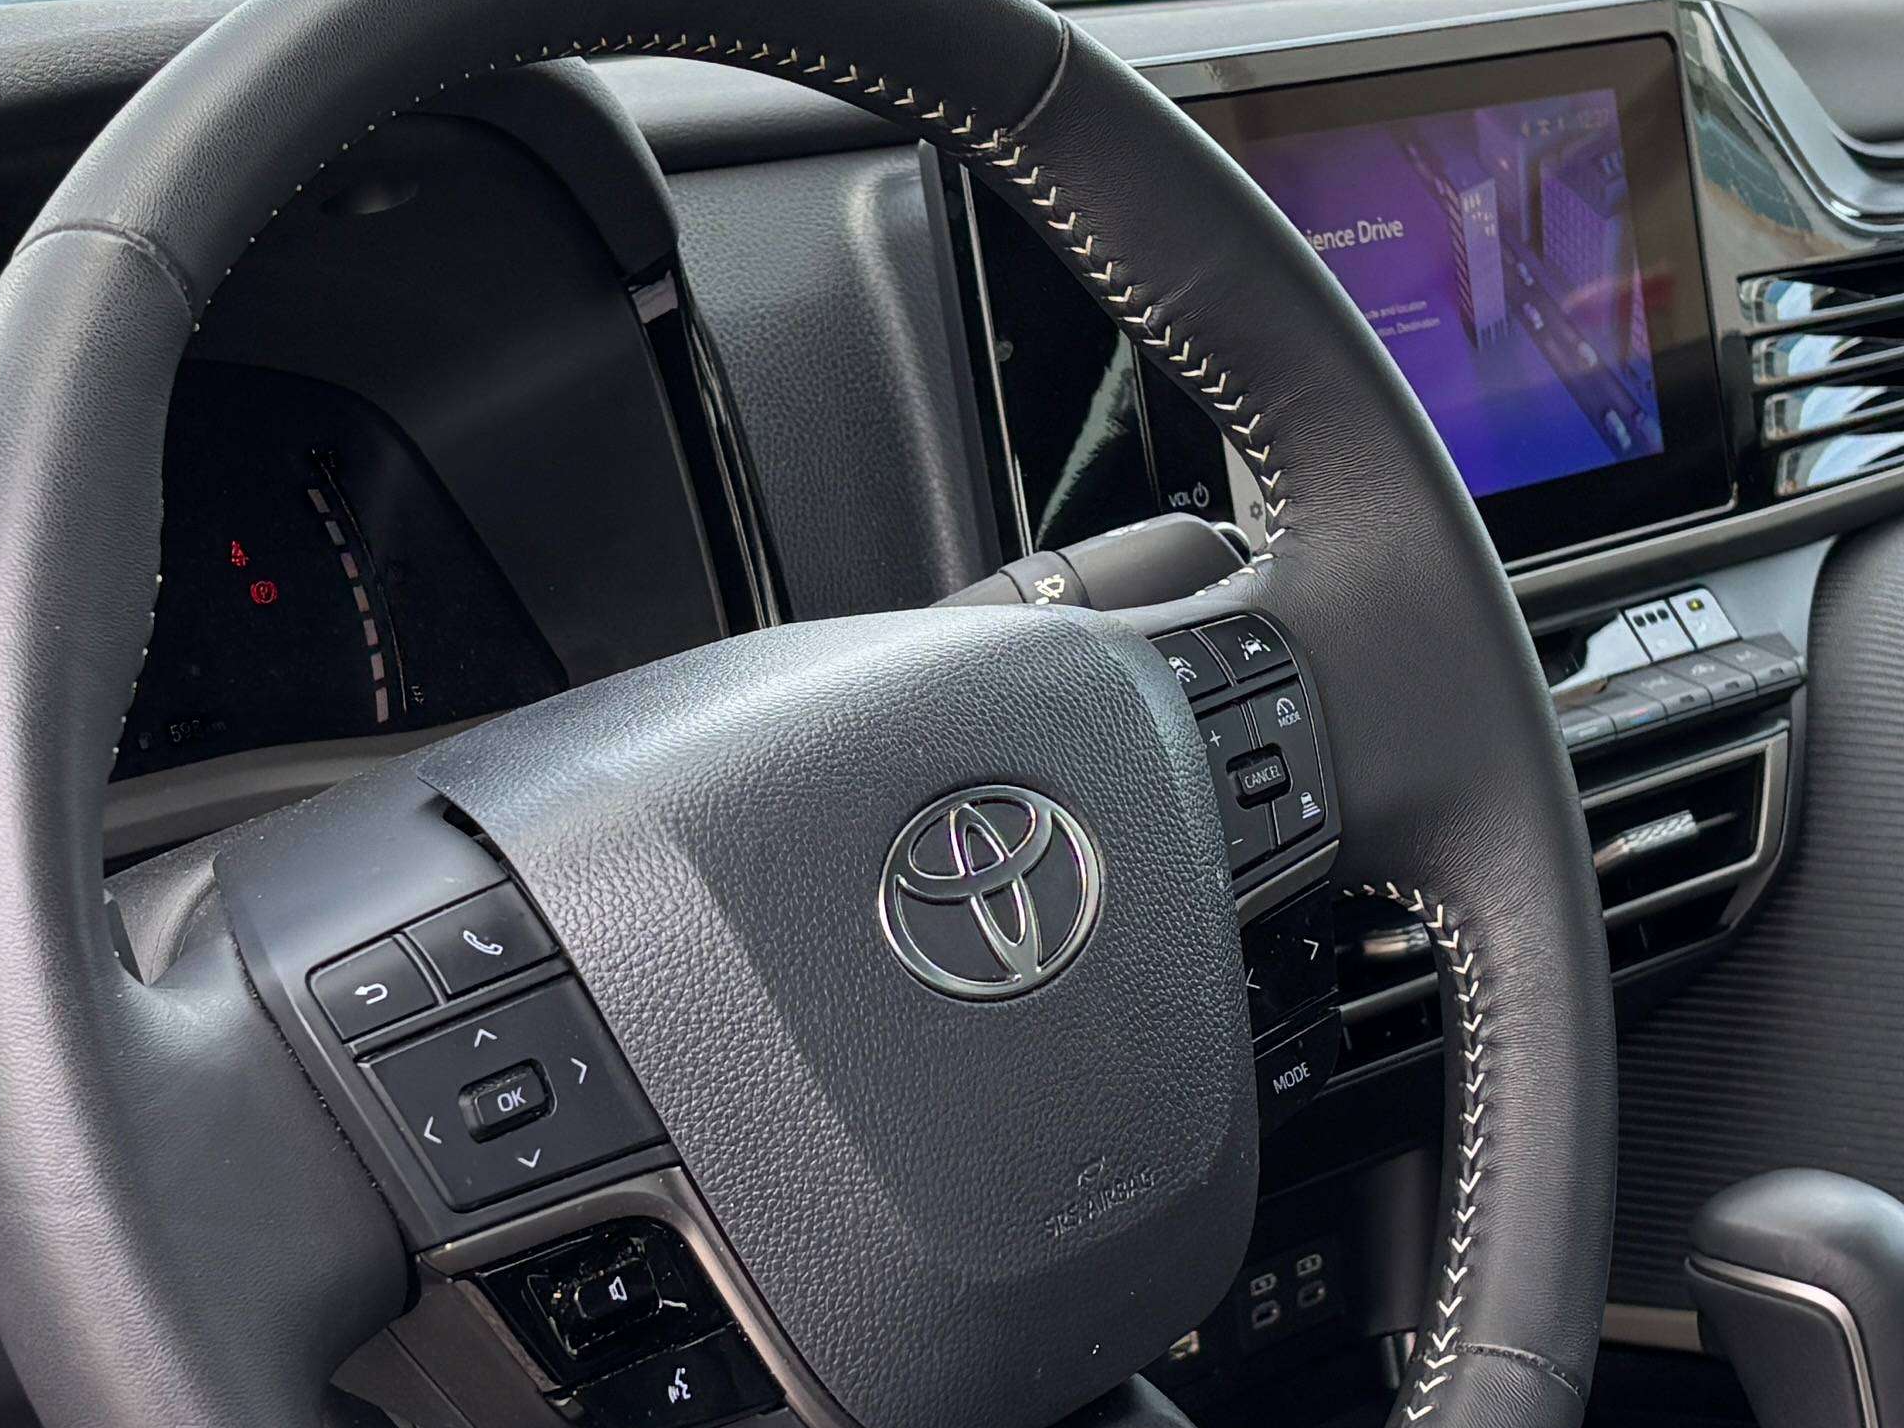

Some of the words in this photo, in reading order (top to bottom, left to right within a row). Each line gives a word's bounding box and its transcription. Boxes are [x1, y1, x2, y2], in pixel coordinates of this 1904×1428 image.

[1357, 217, 1404, 244] Drive
[1168, 491, 1192, 508] VOL
[1244, 765, 1282, 789] CANCEL
[1272, 1061, 1312, 1095] MODE
[497, 1086, 528, 1113] OK
